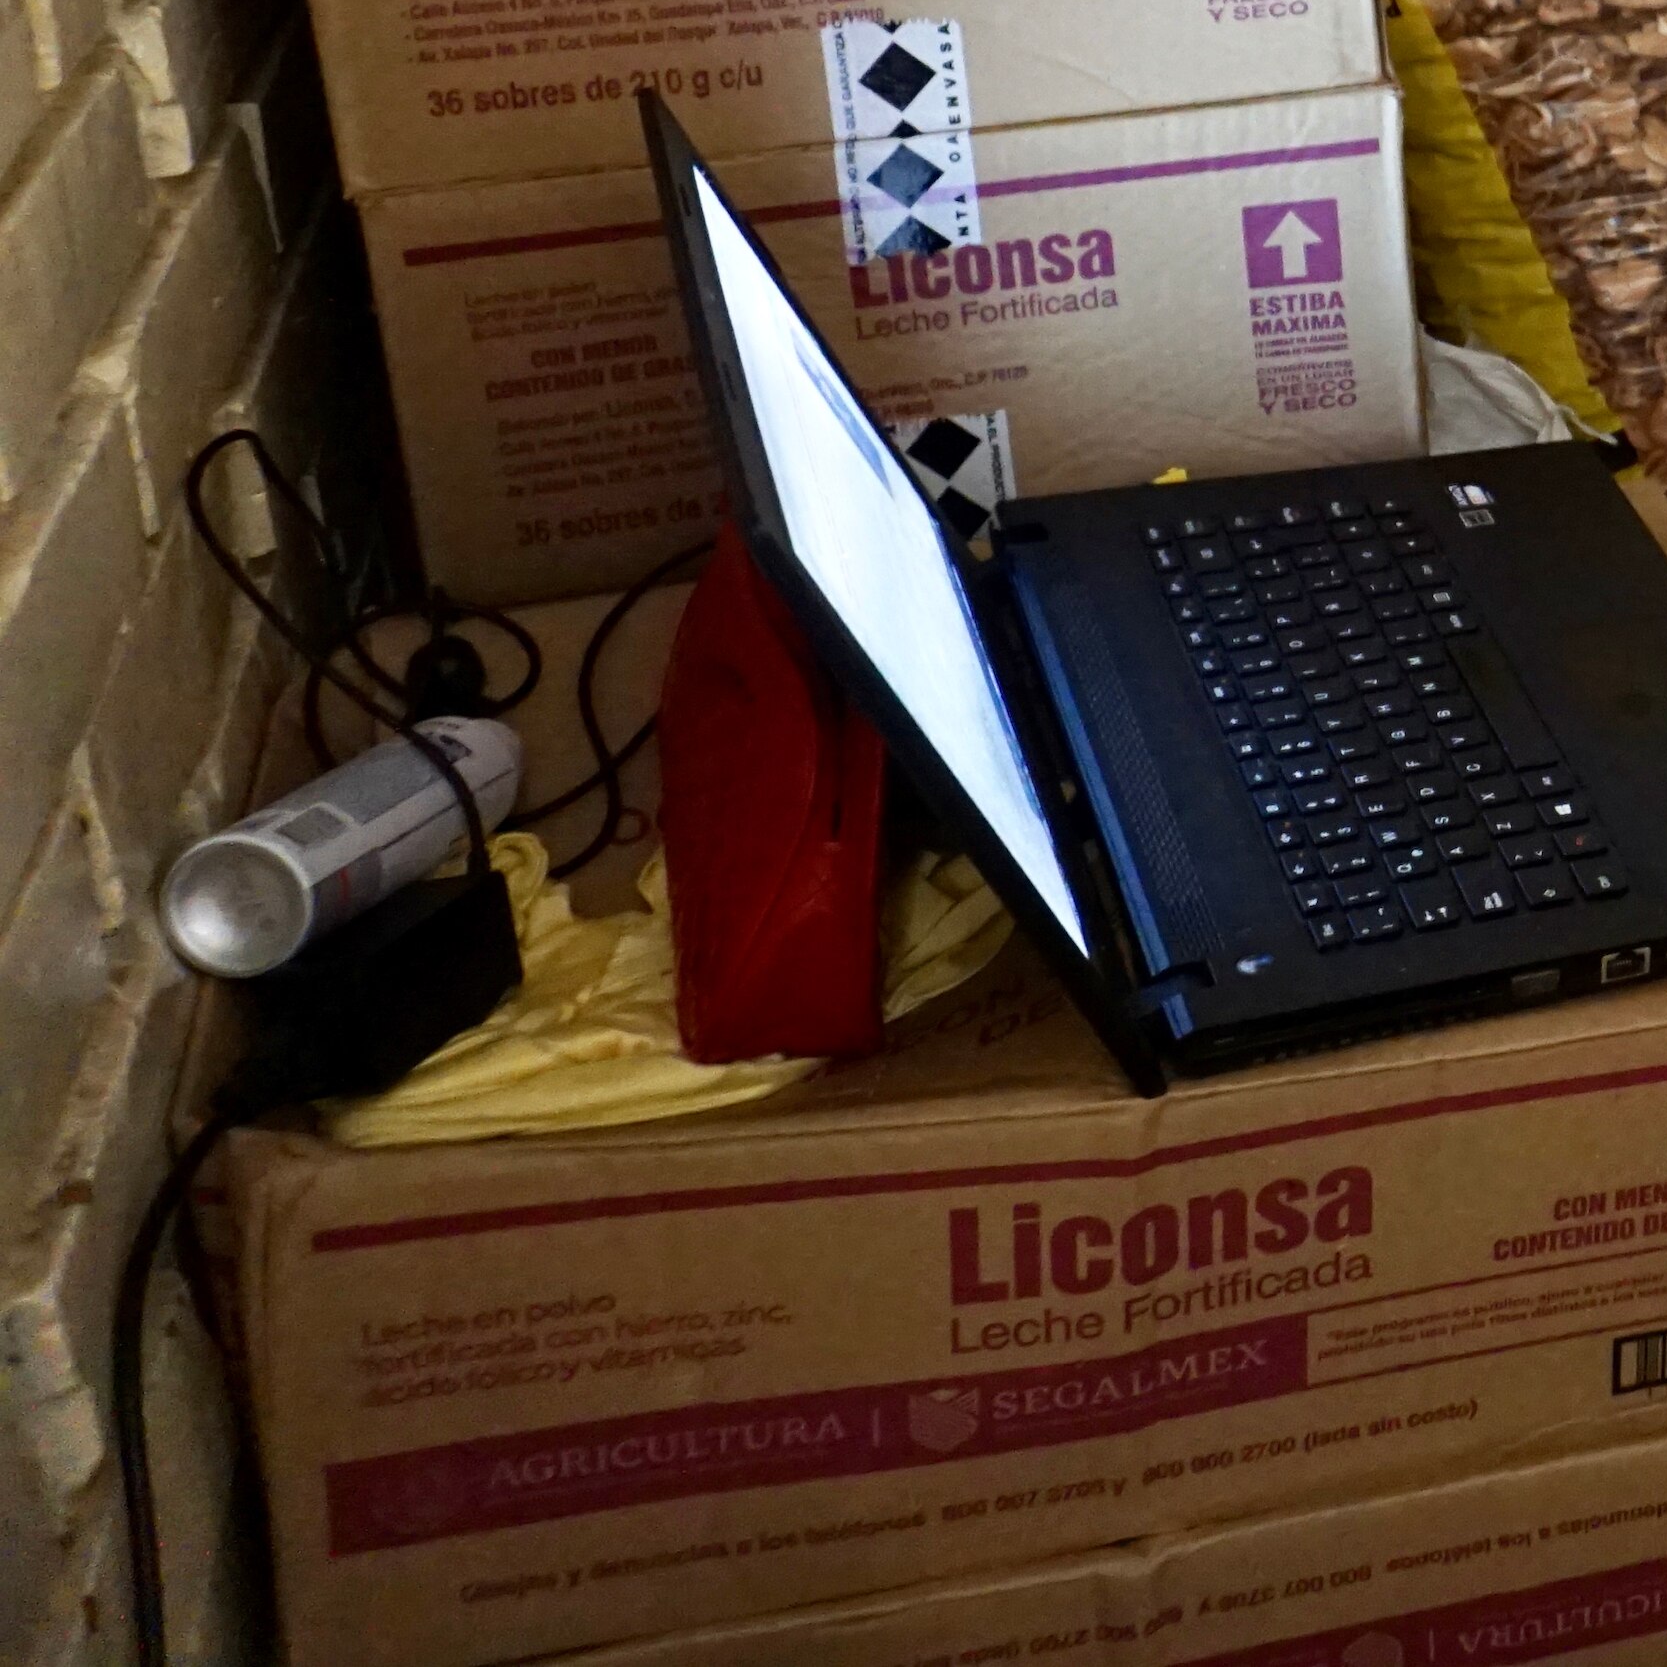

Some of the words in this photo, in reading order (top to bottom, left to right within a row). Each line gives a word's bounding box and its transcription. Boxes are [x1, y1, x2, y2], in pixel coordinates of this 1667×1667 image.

[1206, 7, 1225, 23] Y
[1232, 0, 1309, 21] SECO
[427, 88, 463, 117] 36
[473, 75, 577, 114] sobres
[584, 73, 622, 102] de
[692, 69, 711, 100] g
[719, 59, 763, 91] c/u
[848, 228, 1116, 310] Liconsa
[855, 309, 951, 341] Leche
[960, 286, 1119, 326] Fortificada
[1248, 290, 1346, 317] ESTIBA
[1251, 313, 1347, 337] MAXIMA
[530, 347, 576, 369] CON
[581, 334, 659, 362] MENOR
[485, 369, 604, 403] CONTENIDO
[610, 362, 639, 384] DE
[1257, 400, 1277, 415] Y
[1283, 393, 1358, 413] SECO
[1258, 378, 1356, 401] FRESCO
[556, 503, 658, 542] sobres
[666, 495, 706, 530] de
[1551, 1192, 1608, 1223] CON
[947, 1164, 1375, 1307] Liconsa
[1491, 1217, 1637, 1262] CONTENIDO
[950, 1306, 1107, 1356] Leche
[1121, 1246, 1375, 1336] Fortificada
[989, 1337, 1270, 1423] SEGALMEX
[489, 1410, 850, 1491] AGRICULTURA
[1240, 1434, 1299, 1465] 2700
[1367, 1410, 1402, 1436] sin
[1406, 1396, 1481, 1429] costo)
